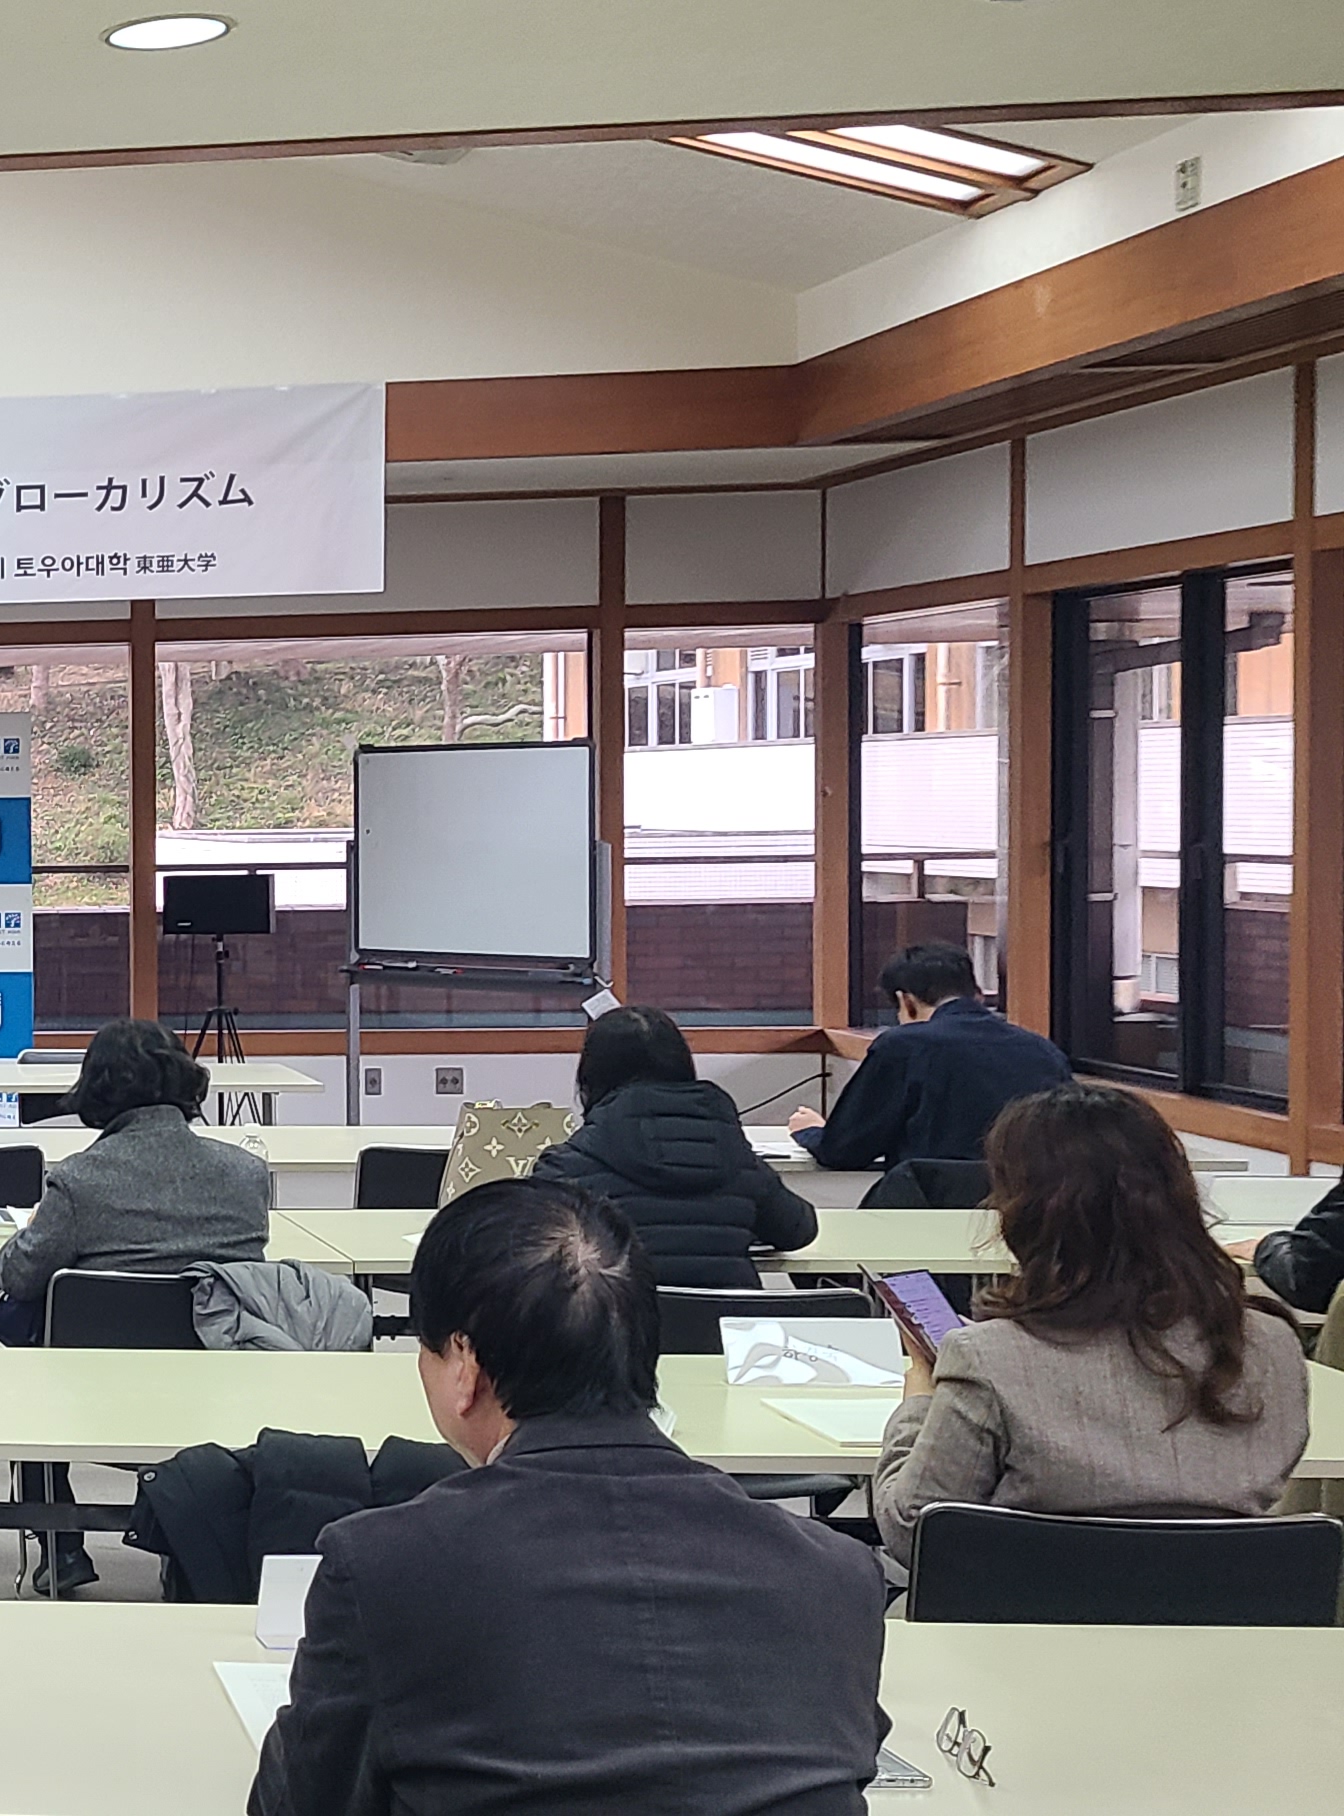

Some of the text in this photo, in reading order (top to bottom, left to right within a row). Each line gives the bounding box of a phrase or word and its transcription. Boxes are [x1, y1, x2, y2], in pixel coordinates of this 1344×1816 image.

[14, 551, 131, 579] 토우아대학
[135, 551, 218, 575] 東亜大学
